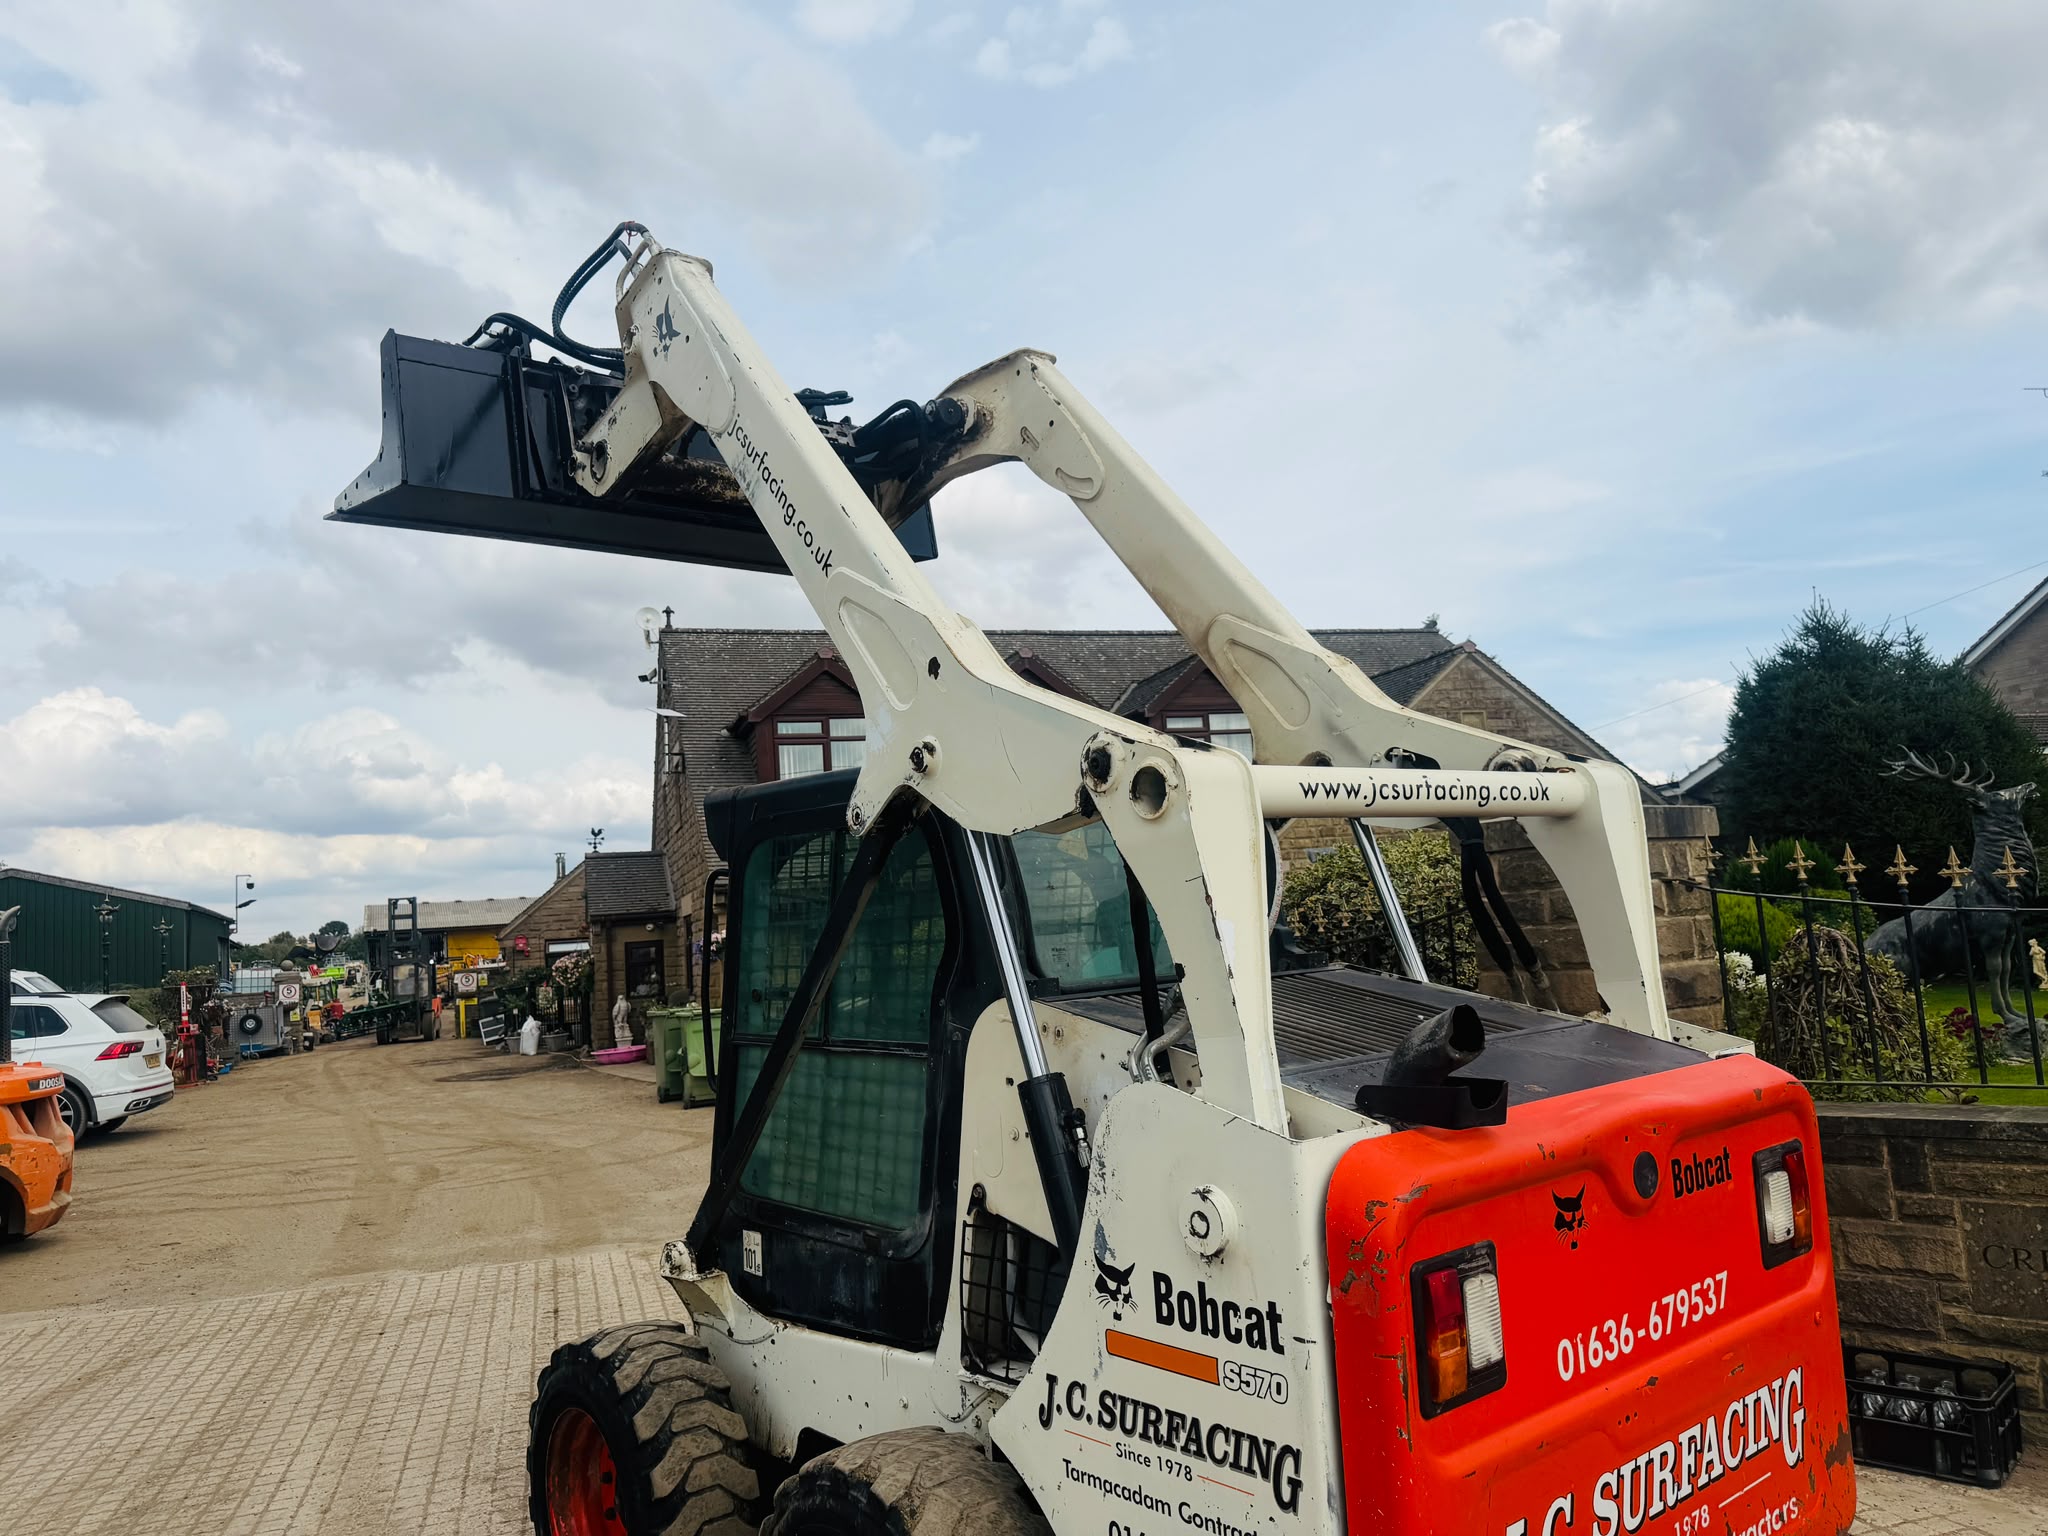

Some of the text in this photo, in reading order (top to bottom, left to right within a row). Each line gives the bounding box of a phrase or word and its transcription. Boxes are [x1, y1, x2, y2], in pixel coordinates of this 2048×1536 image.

[727, 413, 833, 578] jcsurfacing.co.uk
[1299, 776, 1550, 808] www.jcsurfacing.co.uk
[1670, 1146, 1733, 1199] Bobcat
[744, 1247, 756, 1273] 101
[1152, 1270, 1285, 1356] Bobcat
[1557, 1270, 1728, 1382] 01636-679537
[1222, 1360, 1289, 1405] S570
[1097, 1389, 1304, 1517] SURFACING
[1115, 1442, 1193, 1482] Since 1978
[1591, 1366, 1805, 1536] SURFACING
[1062, 1458, 1172, 1517] Tarmacadam
